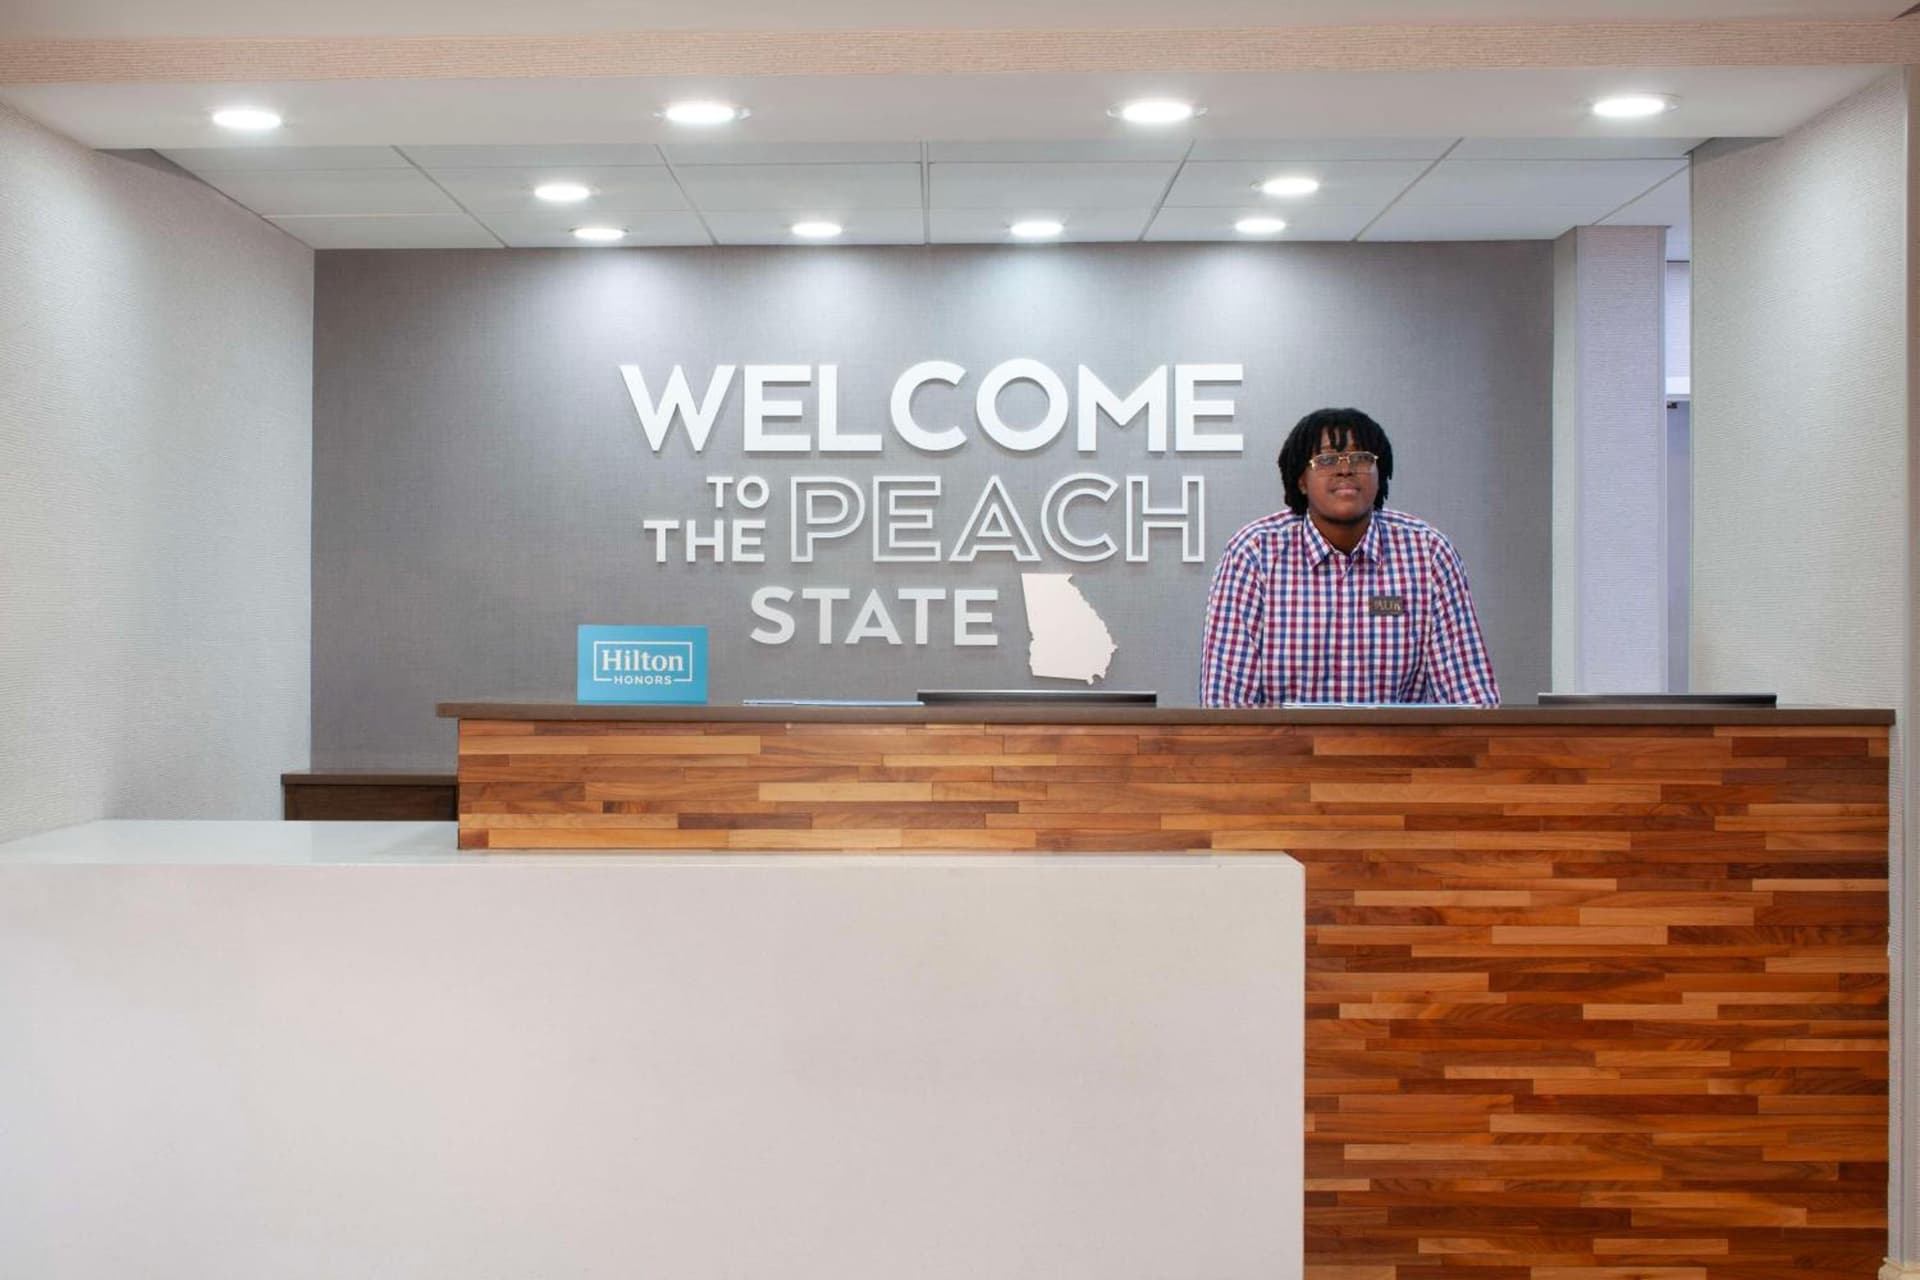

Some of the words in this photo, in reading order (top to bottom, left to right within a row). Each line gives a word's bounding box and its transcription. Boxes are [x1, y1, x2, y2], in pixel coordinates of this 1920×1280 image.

[620, 358, 1244, 452] WELCOME
[705, 475, 770, 508] TO
[643, 518, 766, 563] THE
[790, 473, 1205, 563] PEACH
[749, 586, 999, 646] STATE
[602, 649, 684, 672] Hilton
[614, 675, 673, 686] HONORS
